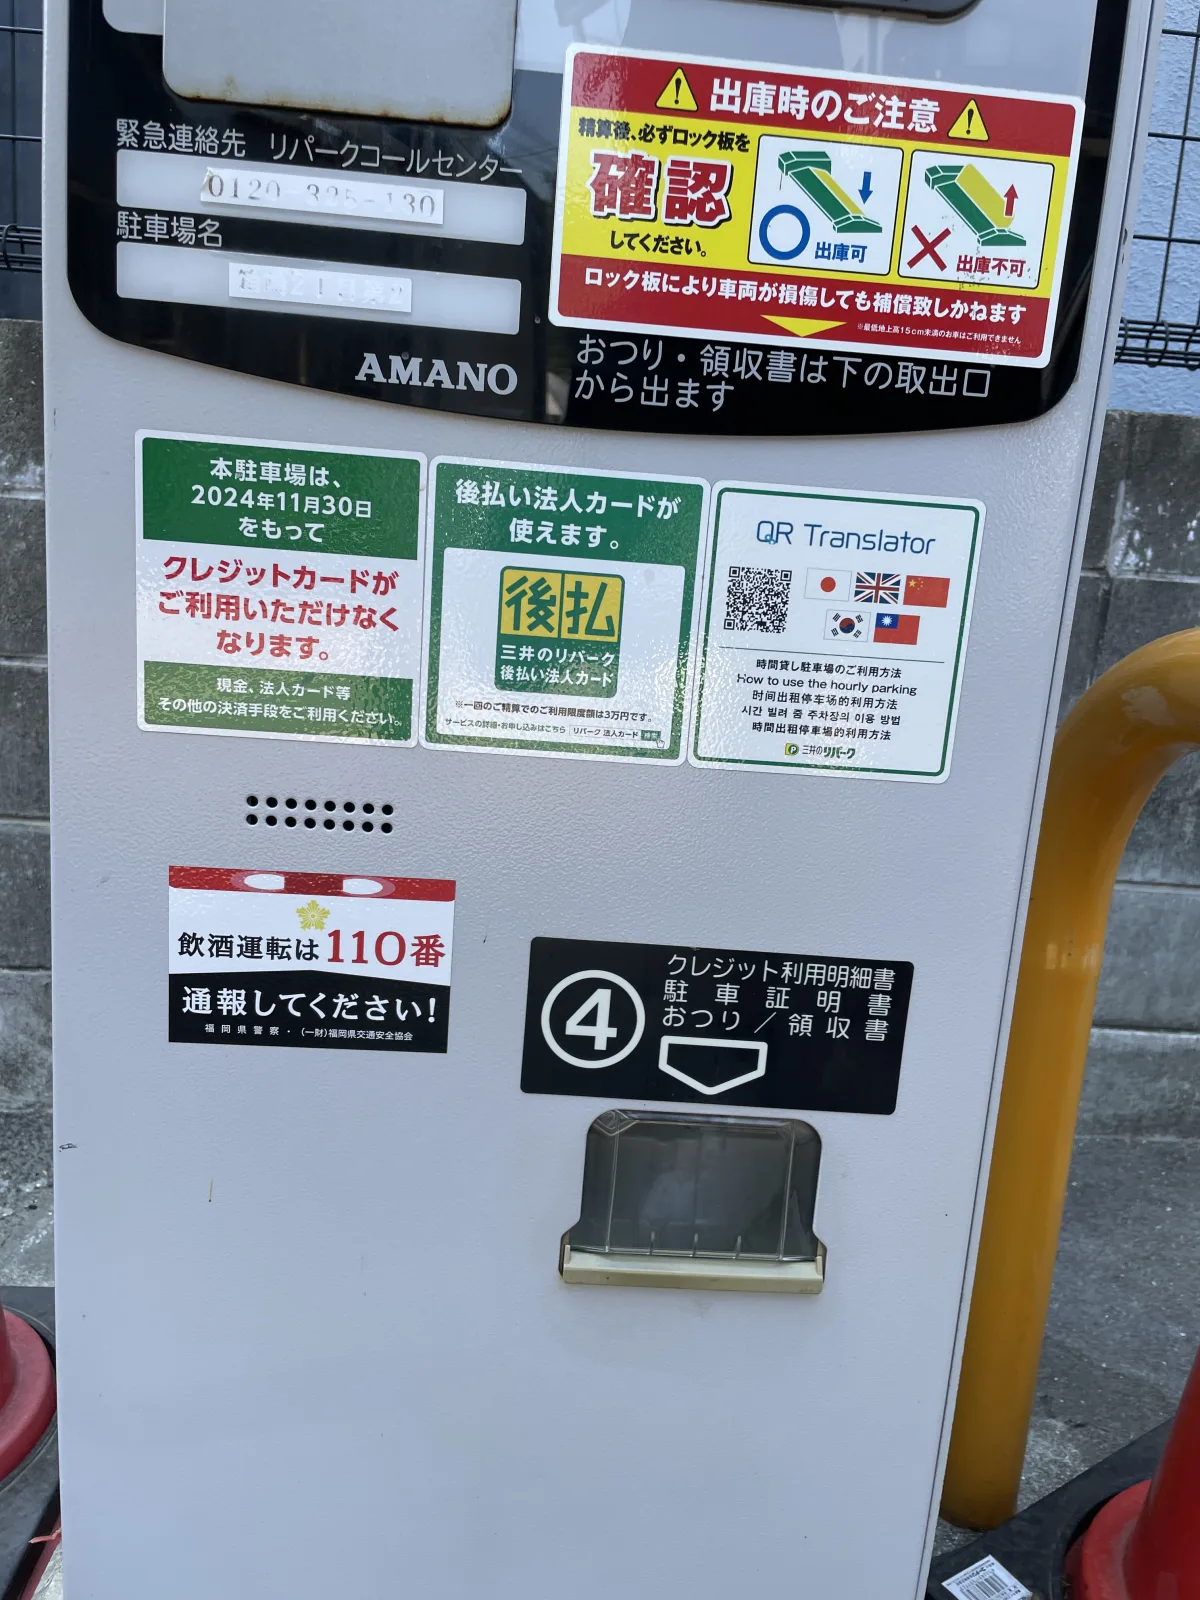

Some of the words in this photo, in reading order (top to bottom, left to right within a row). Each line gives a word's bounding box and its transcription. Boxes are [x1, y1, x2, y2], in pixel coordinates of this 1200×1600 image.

[709, 77, 941, 135] 出庫時のご注意
[116, 118, 246, 158] 緊急連絡先
[270, 134, 523, 182] リパークコールセンター
[578, 117, 750, 152] 精算後、必ずロック板を
[587, 150, 733, 228] 確認
[116, 211, 223, 248] 駐車場名
[610, 230, 706, 257] してください。
[814, 241, 868, 264] 出庫可
[956, 254, 1026, 279] 出庫不可
[584, 267, 1027, 324] ロック板により車両が損傷しても補償致しかねます
[355, 352, 518, 396] AMANO
[576, 334, 991, 398] おつり・領収書は下の取出口
[574, 371, 734, 412] から出ます
[209, 457, 341, 489] 本駐車場は、
[191, 485, 371, 518] 2024年11月30日
[455, 478, 682, 520] 後払い法人カードが
[238, 517, 325, 543] をもって
[508, 518, 619, 550] 使えます。
[756, 520, 794, 545] QR
[803, 523, 936, 555] Translator
[163, 556, 399, 596] クレジットカードが
[158, 590, 399, 632] ご利用いただけなく
[505, 575, 616, 638] 後払
[217, 629, 328, 661] なります。
[500, 644, 616, 667] 三井のリパーク
[499, 665, 614, 688] 後払い法人カード
[736, 673, 764, 684] How
[767, 676, 779, 686] to
[782, 679, 804, 688] use
[808, 678, 827, 689] the
[830, 680, 869, 693] hourly
[871, 683, 917, 696] parking
[756, 659, 902, 679] 時間貸し駐車場のご利用方法
[216, 677, 351, 701] 現金、法人カード等
[752, 690, 898, 710] 时间出租停车场的利用方法
[157, 697, 402, 727] その他の決済手段をご利用ください。
[741, 705, 763, 716] 시간
[768, 707, 788, 717] 빌려
[807, 709, 850, 722] 주차장의
[854, 713, 875, 724] 이용
[880, 715, 900, 726] 방법
[752, 722, 891, 741] 時間出租停車場的利用方法
[802, 744, 856, 760] 三井のリパーク
[178, 929, 446, 968] 飲酒運転は110番
[667, 954, 895, 992] クレジット利用明細書
